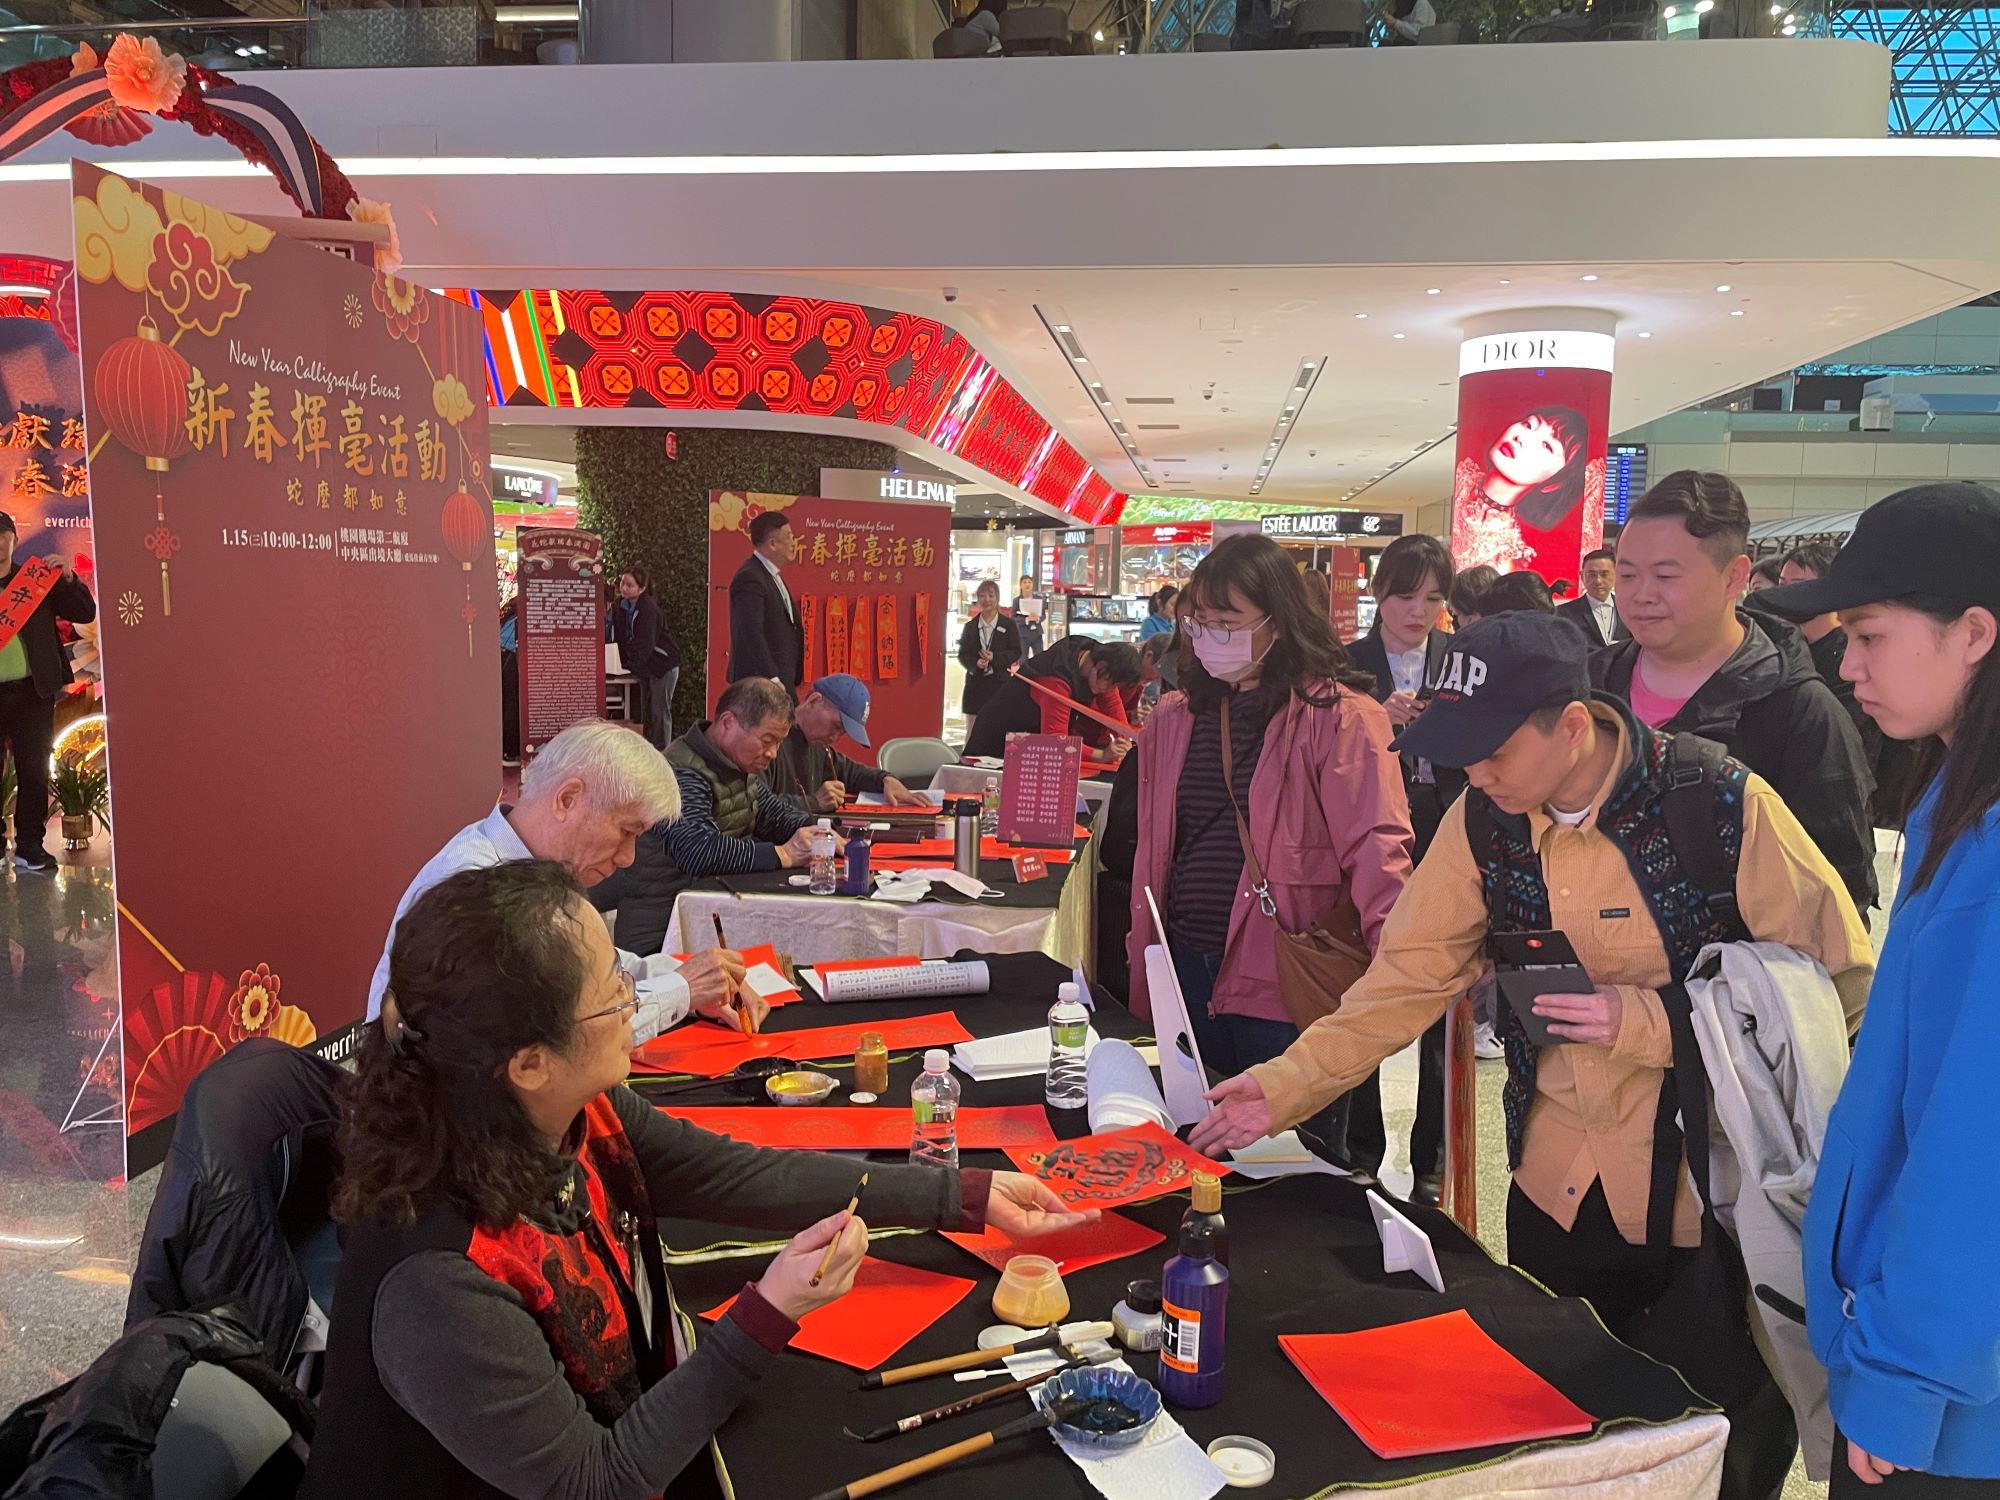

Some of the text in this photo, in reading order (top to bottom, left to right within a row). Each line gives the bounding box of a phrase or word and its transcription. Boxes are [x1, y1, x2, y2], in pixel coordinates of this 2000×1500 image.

[1483, 339, 1557, 364] DIOR
[229, 339, 402, 400] New Year Calligraphy Event
[183, 366, 448, 484] 新春揮毫活動
[880, 477, 945, 502] HELENA
[806, 517, 895, 533] New Year Calligraphy Event
[1293, 515, 1337, 532] LAUDER
